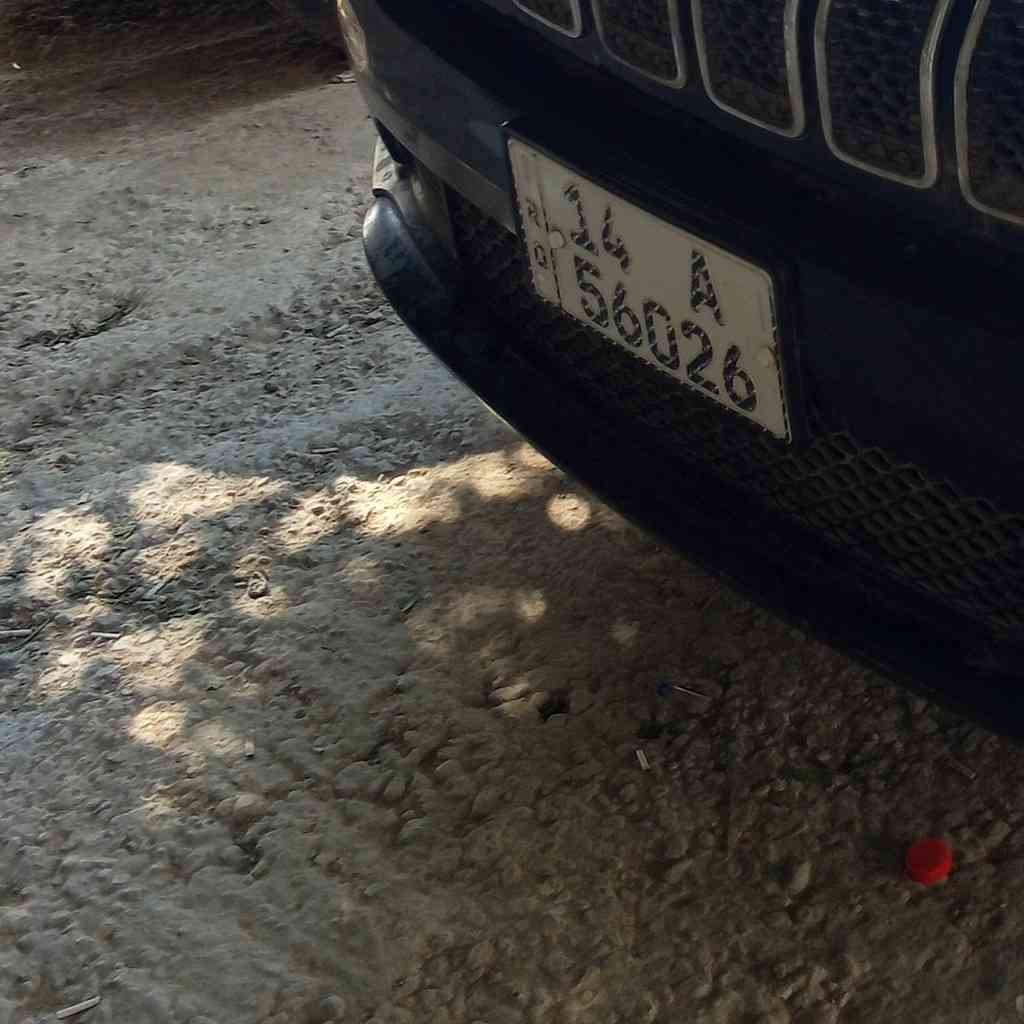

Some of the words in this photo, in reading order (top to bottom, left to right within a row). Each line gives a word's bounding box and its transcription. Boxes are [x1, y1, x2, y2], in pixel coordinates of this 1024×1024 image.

[563, 183, 632, 274] 14
[690, 247, 726, 327] A
[574, 254, 758, 412] 56026
